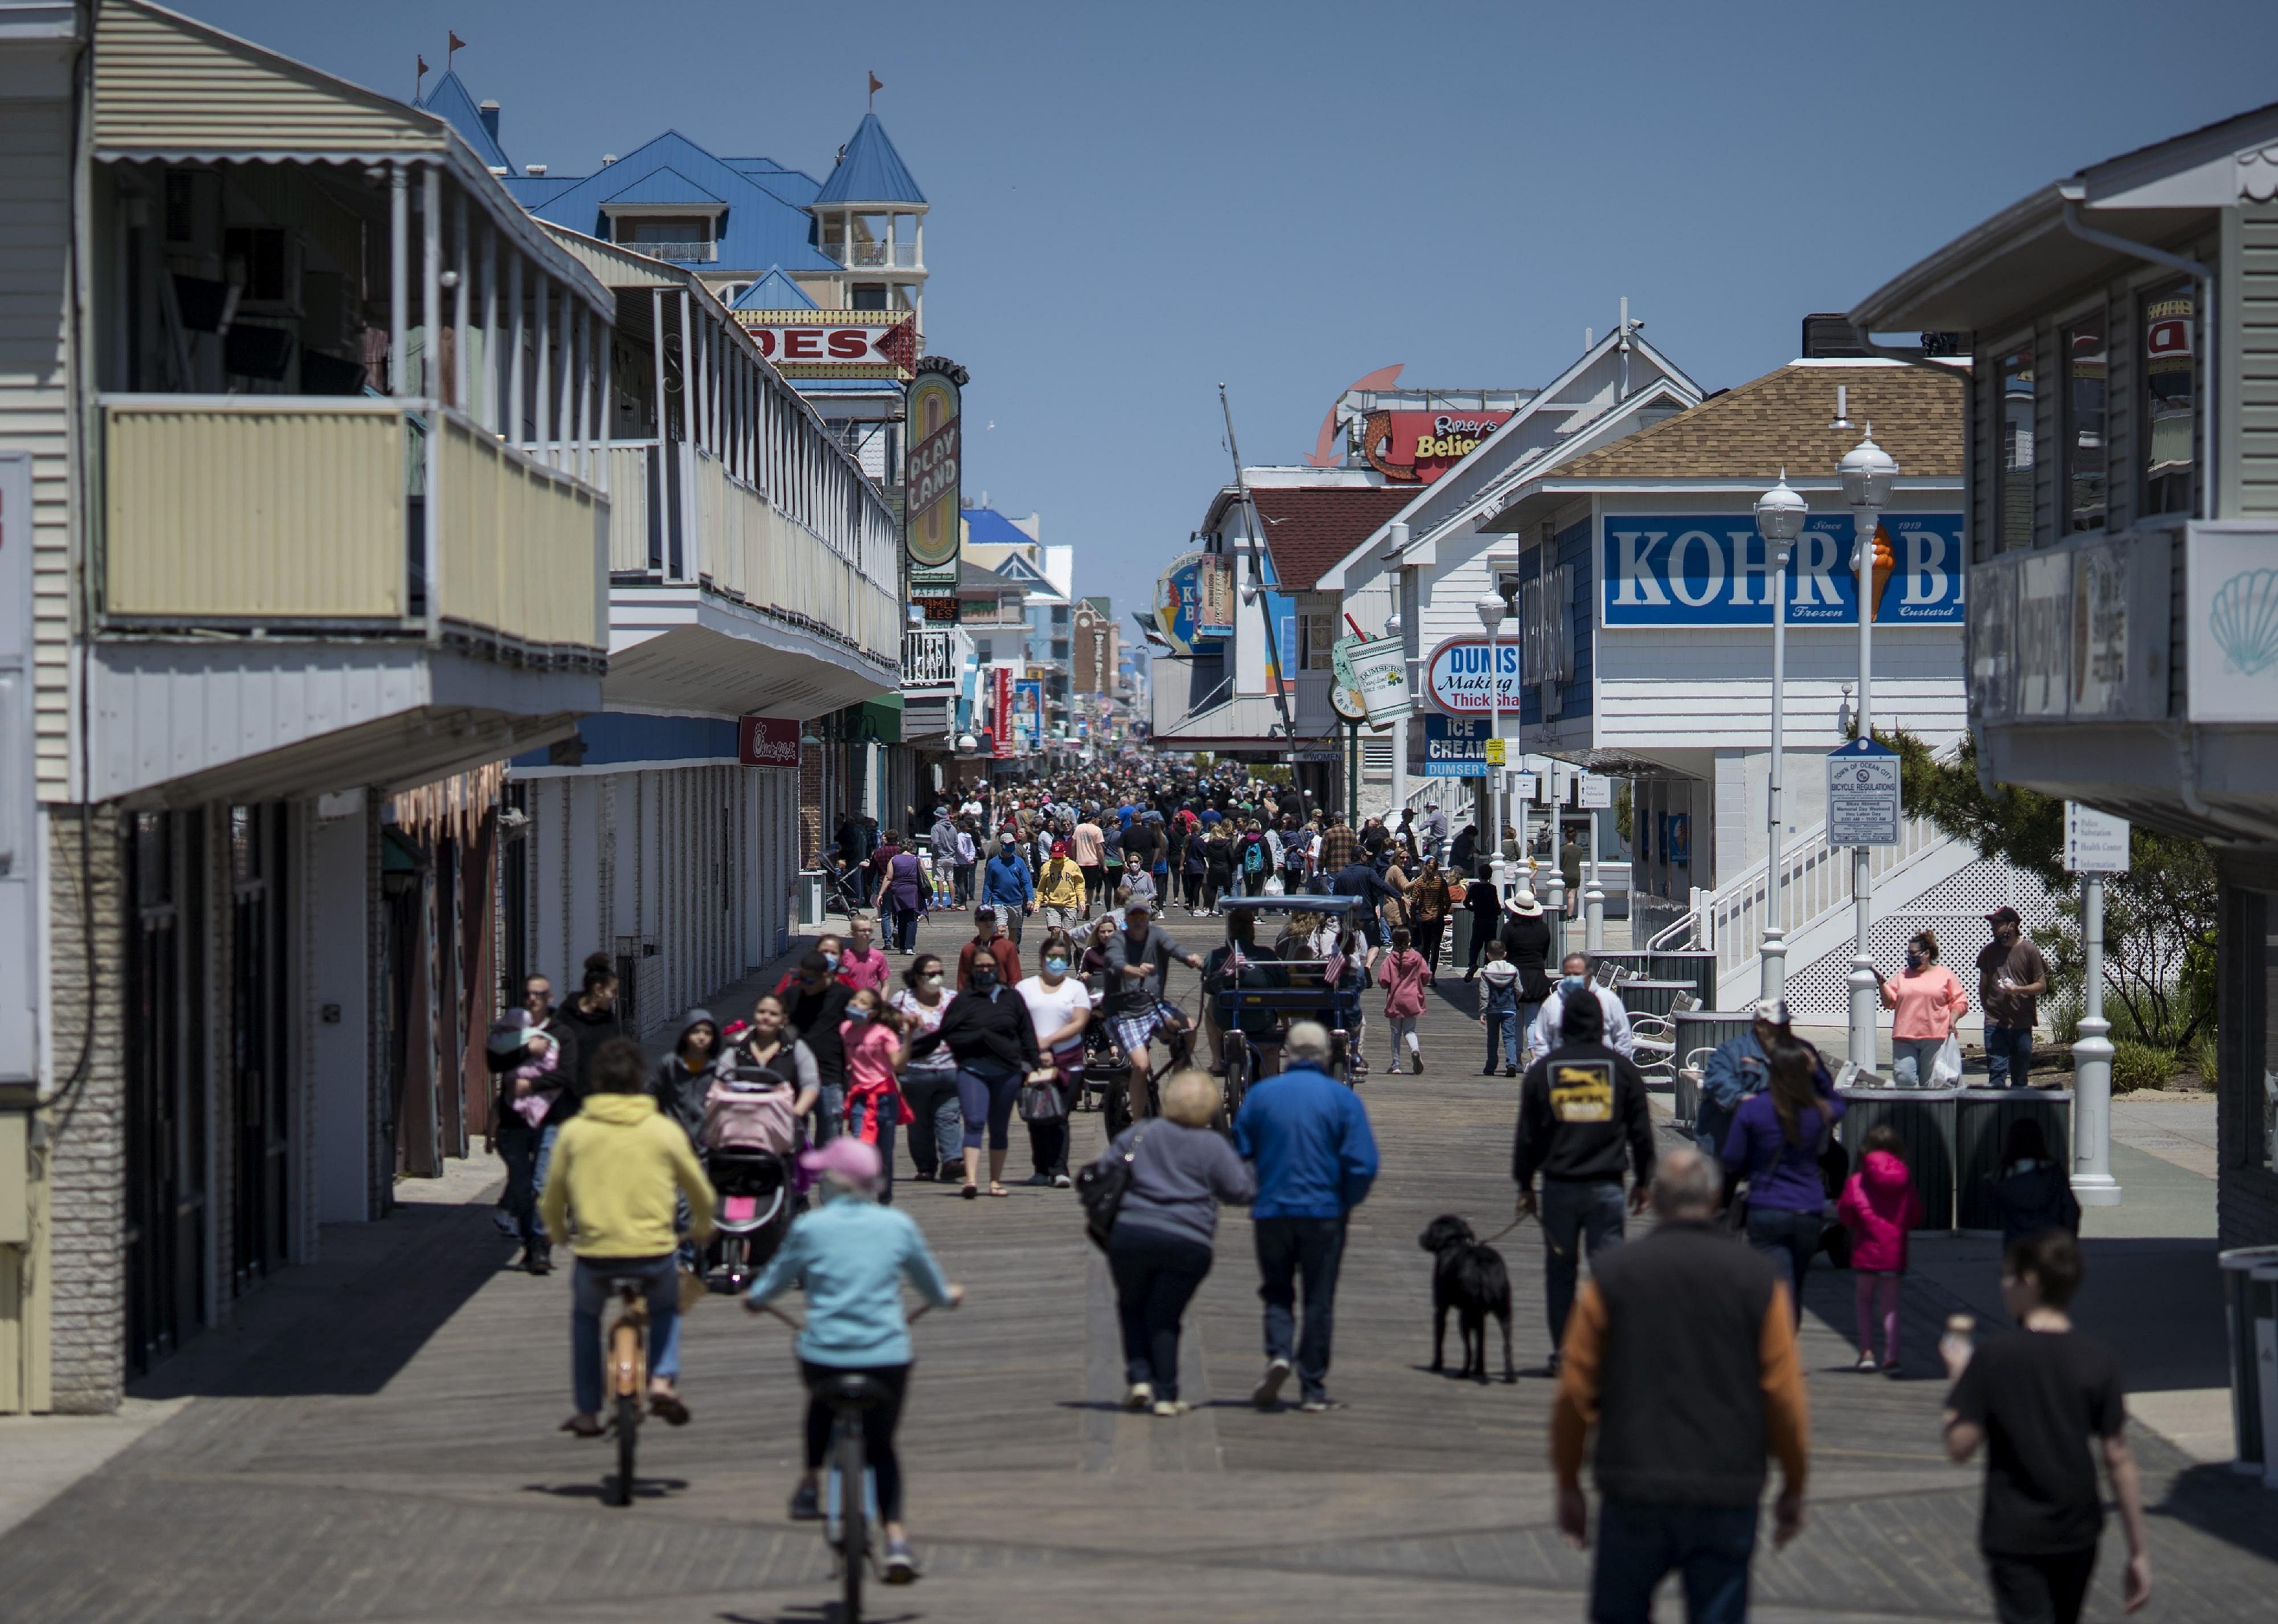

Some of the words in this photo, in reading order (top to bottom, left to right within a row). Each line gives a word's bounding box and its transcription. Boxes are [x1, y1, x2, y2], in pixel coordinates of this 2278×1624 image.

[916, 356, 970, 386] ARTY'S
[911, 427, 956, 482] PLAY
[909, 459, 956, 511] LAND
[1812, 520, 1842, 531] Since
[1897, 521, 1922, 530] 1919
[1611, 530, 1844, 607] KOHR
[912, 587, 947, 596] TAFFY
[1792, 605, 1844, 618] Frozen
[1898, 605, 1954, 617] Custard
[1451, 693, 1490, 707] Thick
[1447, 719, 1475, 737] ICE
[1430, 740, 1486, 758] CREAM
[1311, 753, 1341, 761] WOMEN
[1429, 764, 1489, 775] DUMSER'S
[1834, 766, 1849, 780] TOWN
[1860, 762, 1880, 771] OCEAN
[1880, 769, 1892, 780] CITY
[2081, 842, 2100, 851] Health
[2102, 842, 2122, 851] Center
[1050, 871, 1070, 883] GAP
